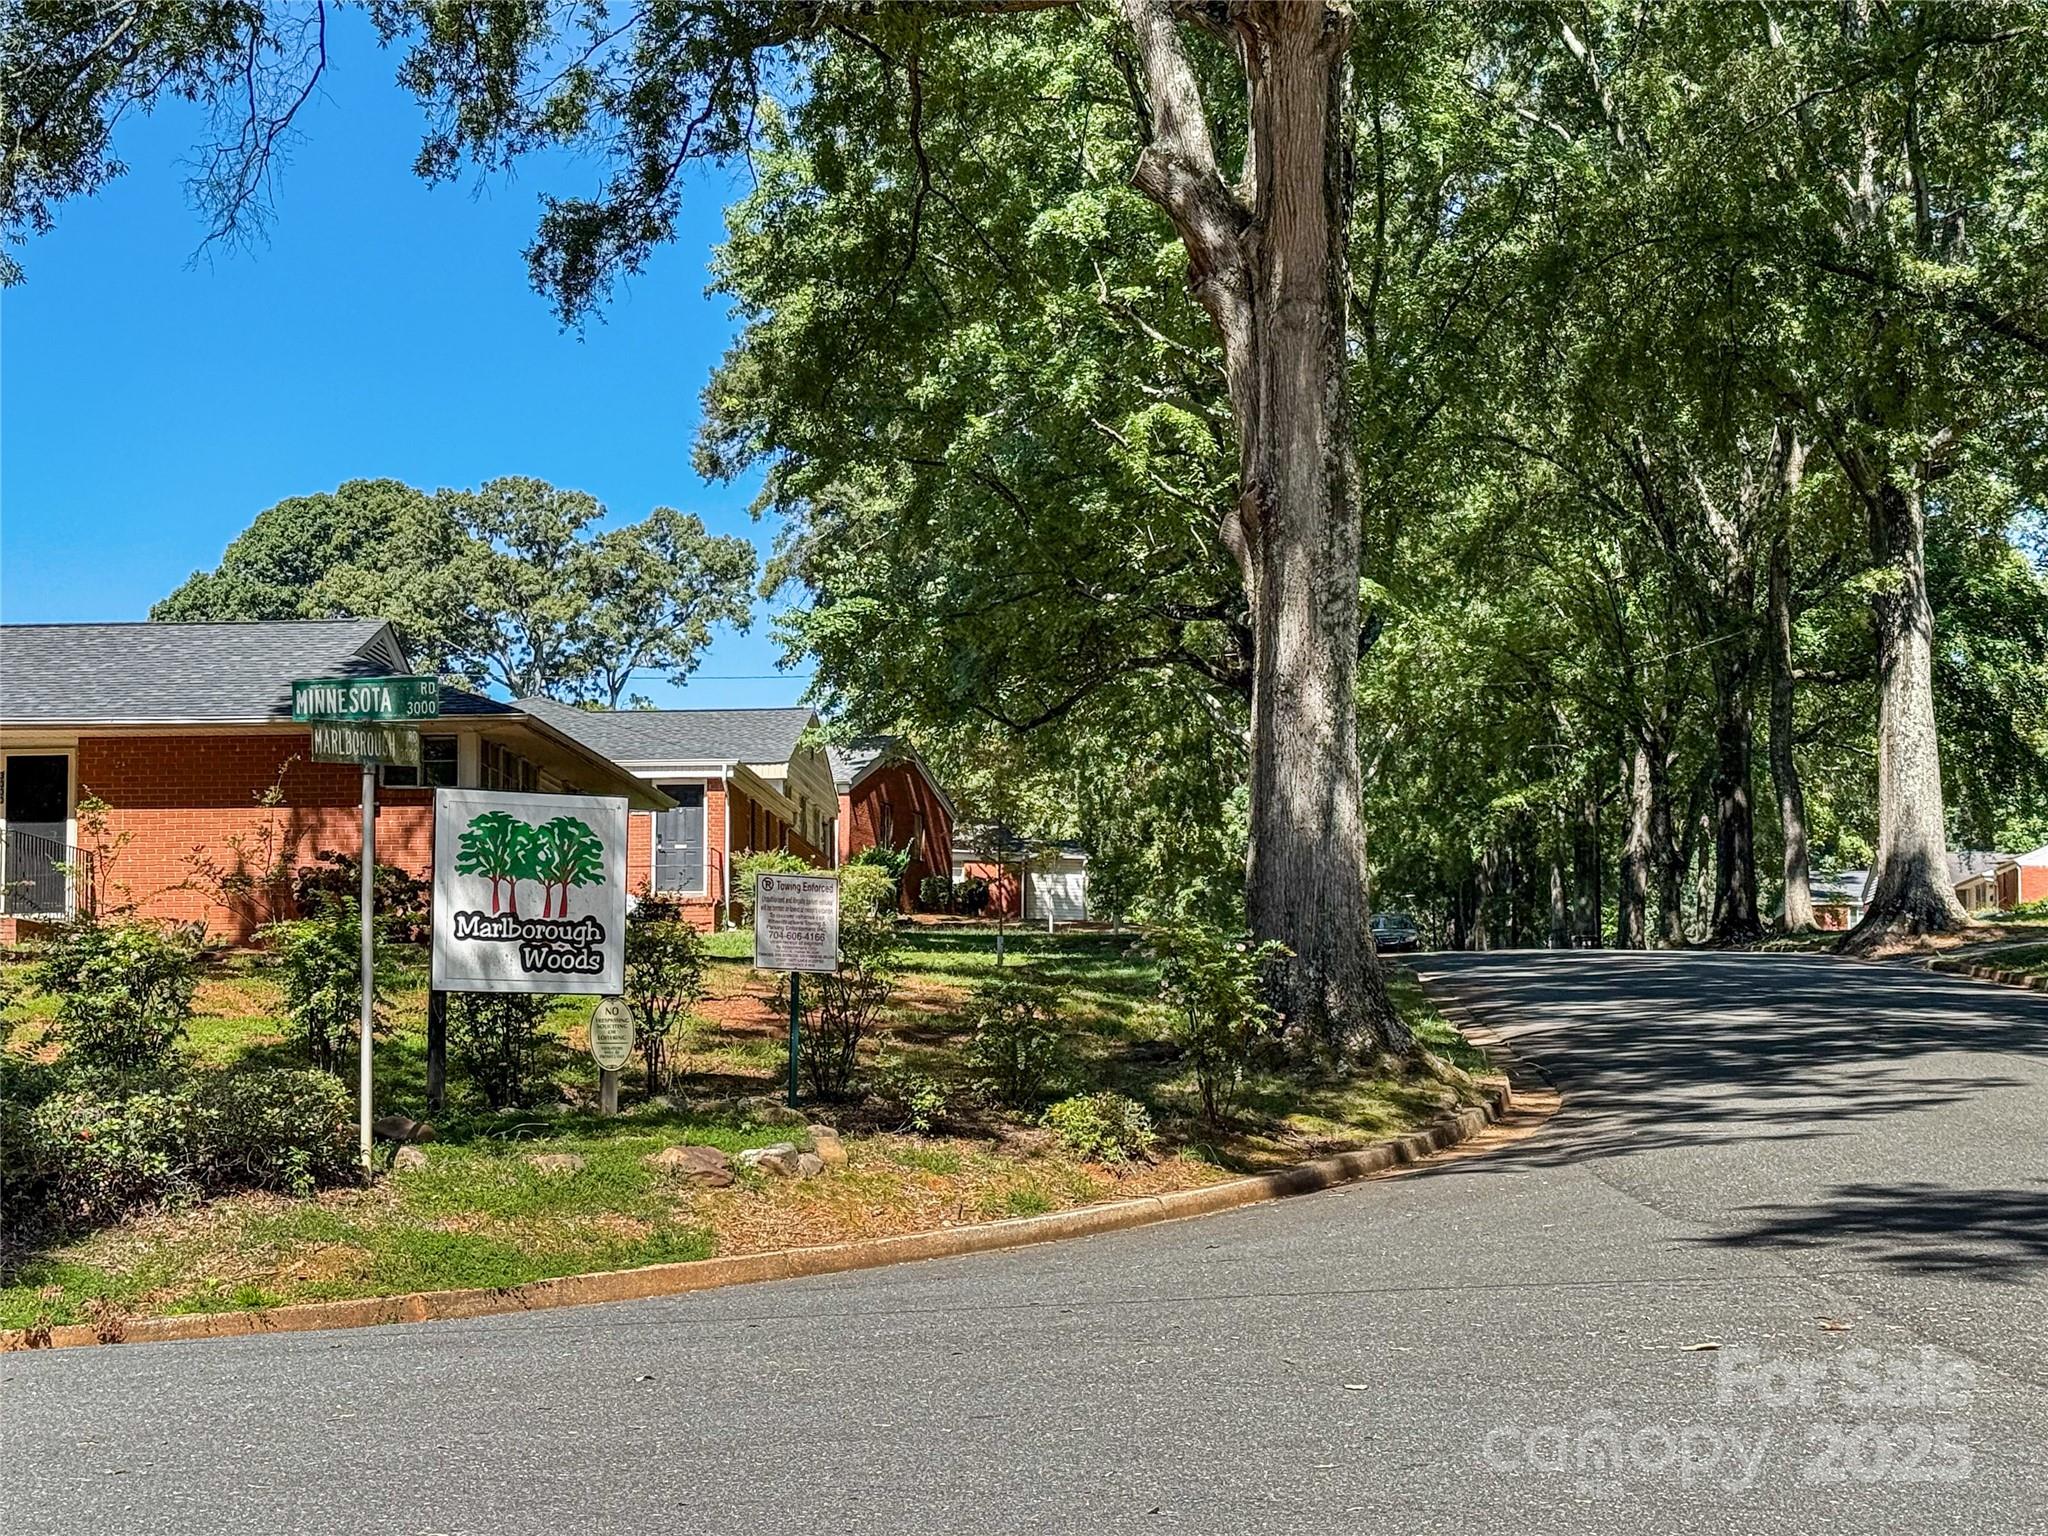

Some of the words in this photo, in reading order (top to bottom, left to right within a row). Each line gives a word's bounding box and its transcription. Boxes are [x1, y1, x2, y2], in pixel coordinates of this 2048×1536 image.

[420, 682, 436, 695] RD
[296, 687, 392, 714] MINNESOTA
[406, 701, 436, 715] 3000
[314, 729, 396, 757] MARLBOROUGH
[776, 881, 801, 894] Towing
[802, 882, 834, 894] Enforced
[456, 916, 601, 947] Marlborough
[768, 931, 826, 942] 704-606-4166
[522, 947, 600, 970] Woods
[605, 1007, 620, 1016] NO
